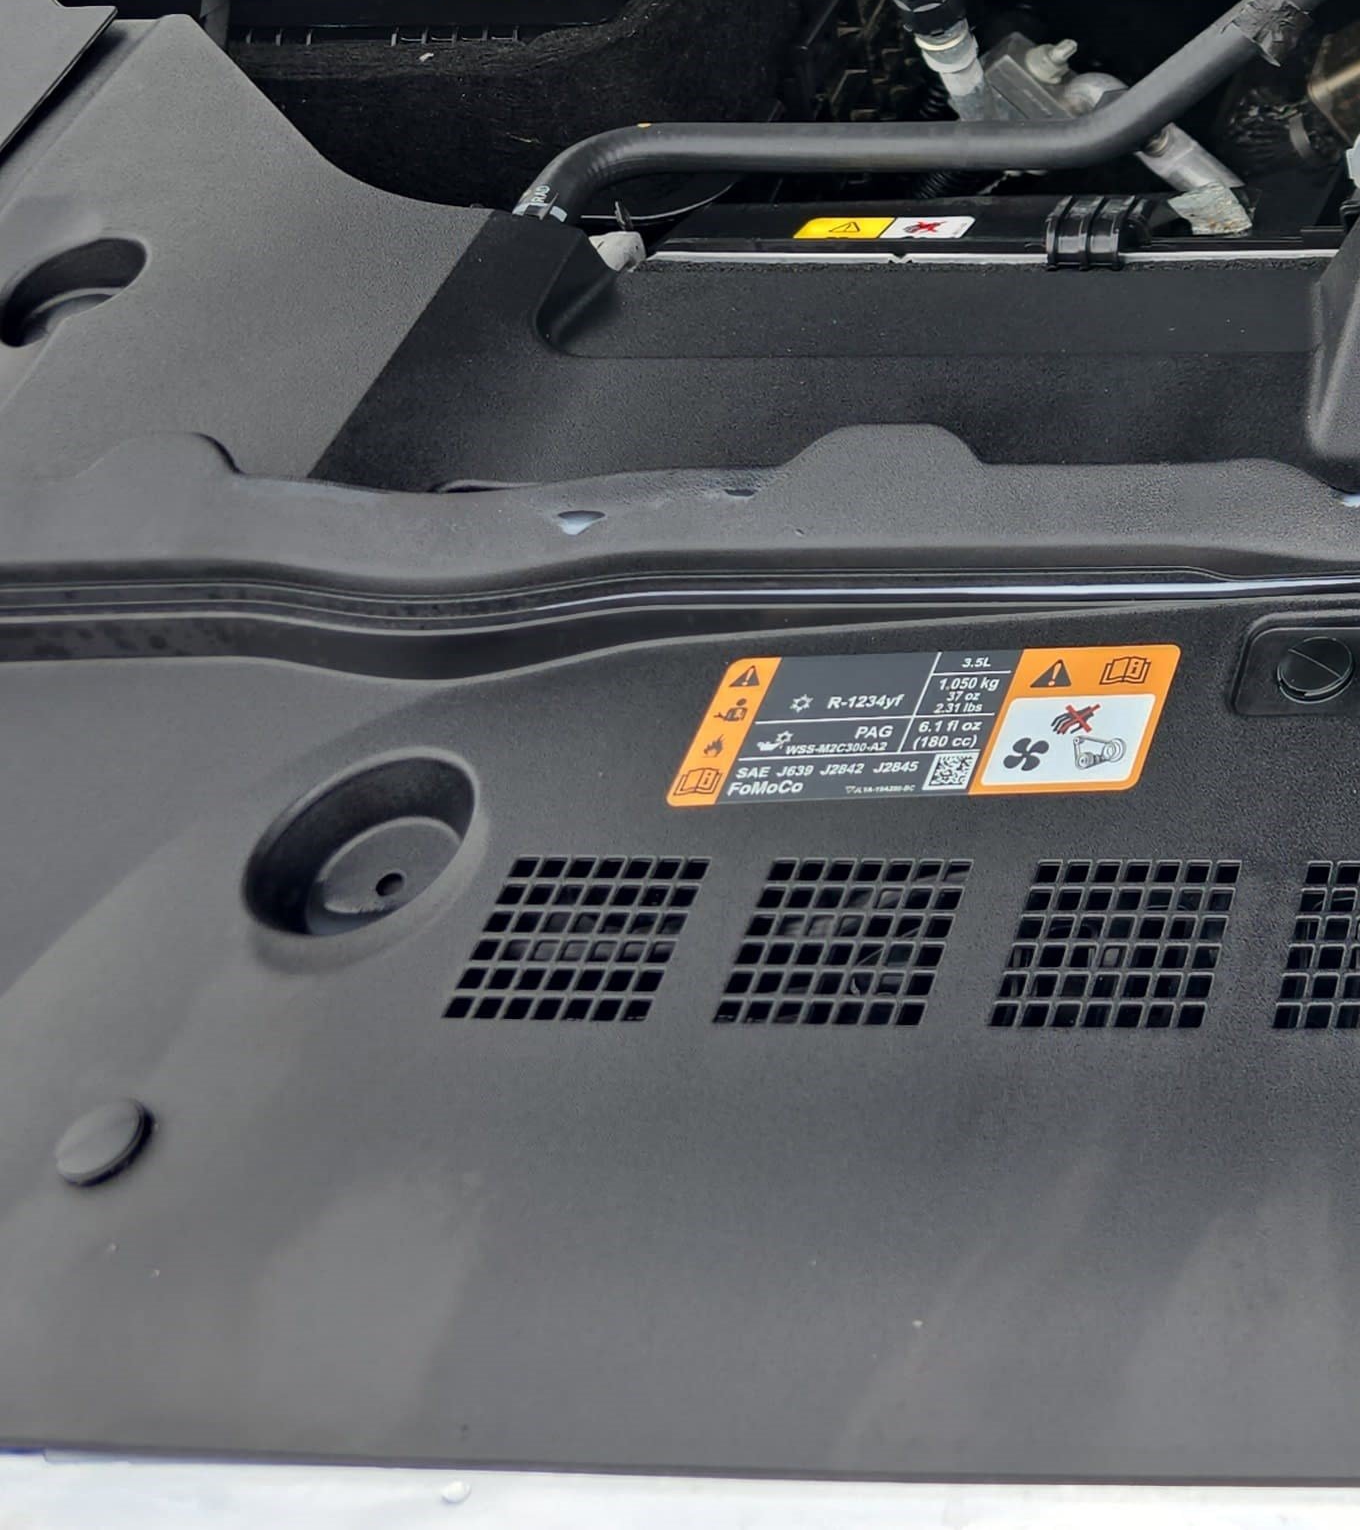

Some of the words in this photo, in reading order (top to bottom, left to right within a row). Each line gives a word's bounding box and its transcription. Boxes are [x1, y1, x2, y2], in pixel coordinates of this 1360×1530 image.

[962, 657, 991, 668] 3.5L
[939, 677, 978, 691] 1.050
[980, 677, 1000, 691] kg
[827, 694, 905, 710] R-1234yf
[946, 691, 963, 701] 37
[964, 692, 981, 701] oz
[934, 703, 960, 713] 2.31
[963, 702, 983, 712] lbs
[854, 724, 894, 740] PAG
[918, 720, 943, 733] 6.1
[947, 720, 959, 732] fl
[962, 721, 983, 732] oz
[913, 735, 948, 750] (180
[952, 734, 978, 748] cc)
[736, 766, 770, 779] SAE
[776, 764, 814, 778] J639
[820, 763, 865, 776] J2842
[728, 780, 803, 796] FoMoCo
